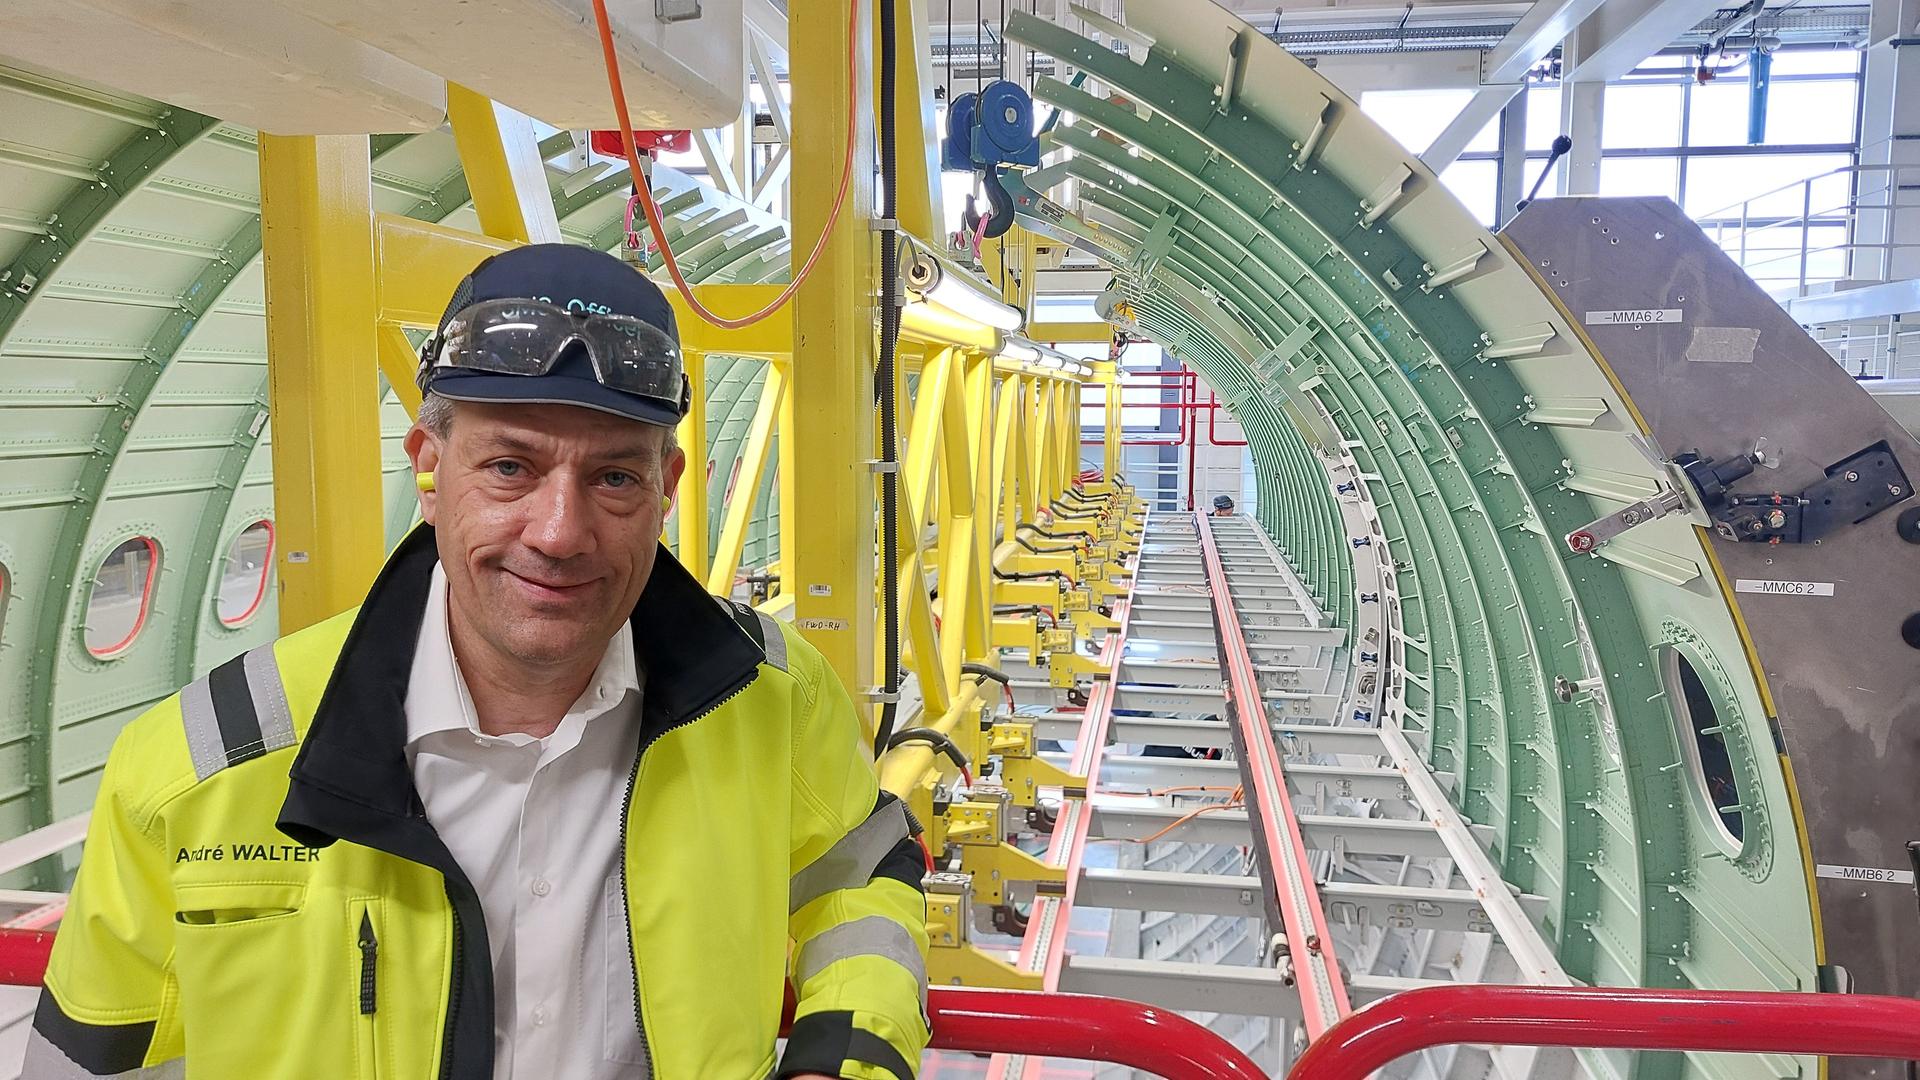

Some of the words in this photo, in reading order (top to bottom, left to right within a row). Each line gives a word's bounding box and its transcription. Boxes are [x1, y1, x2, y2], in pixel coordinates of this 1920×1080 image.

[1604, 311, 1652, 322] -MMA6
[1655, 311, 1664, 322] 2
[1754, 582, 1803, 593] -MMC6
[1806, 583, 1815, 594] 2
[805, 620, 840, 631] FWD-RH
[176, 844, 224, 863] André
[232, 844, 320, 863] WALTER
[1834, 868, 1883, 881] -MMB6
[1886, 870, 1895, 882] 2
